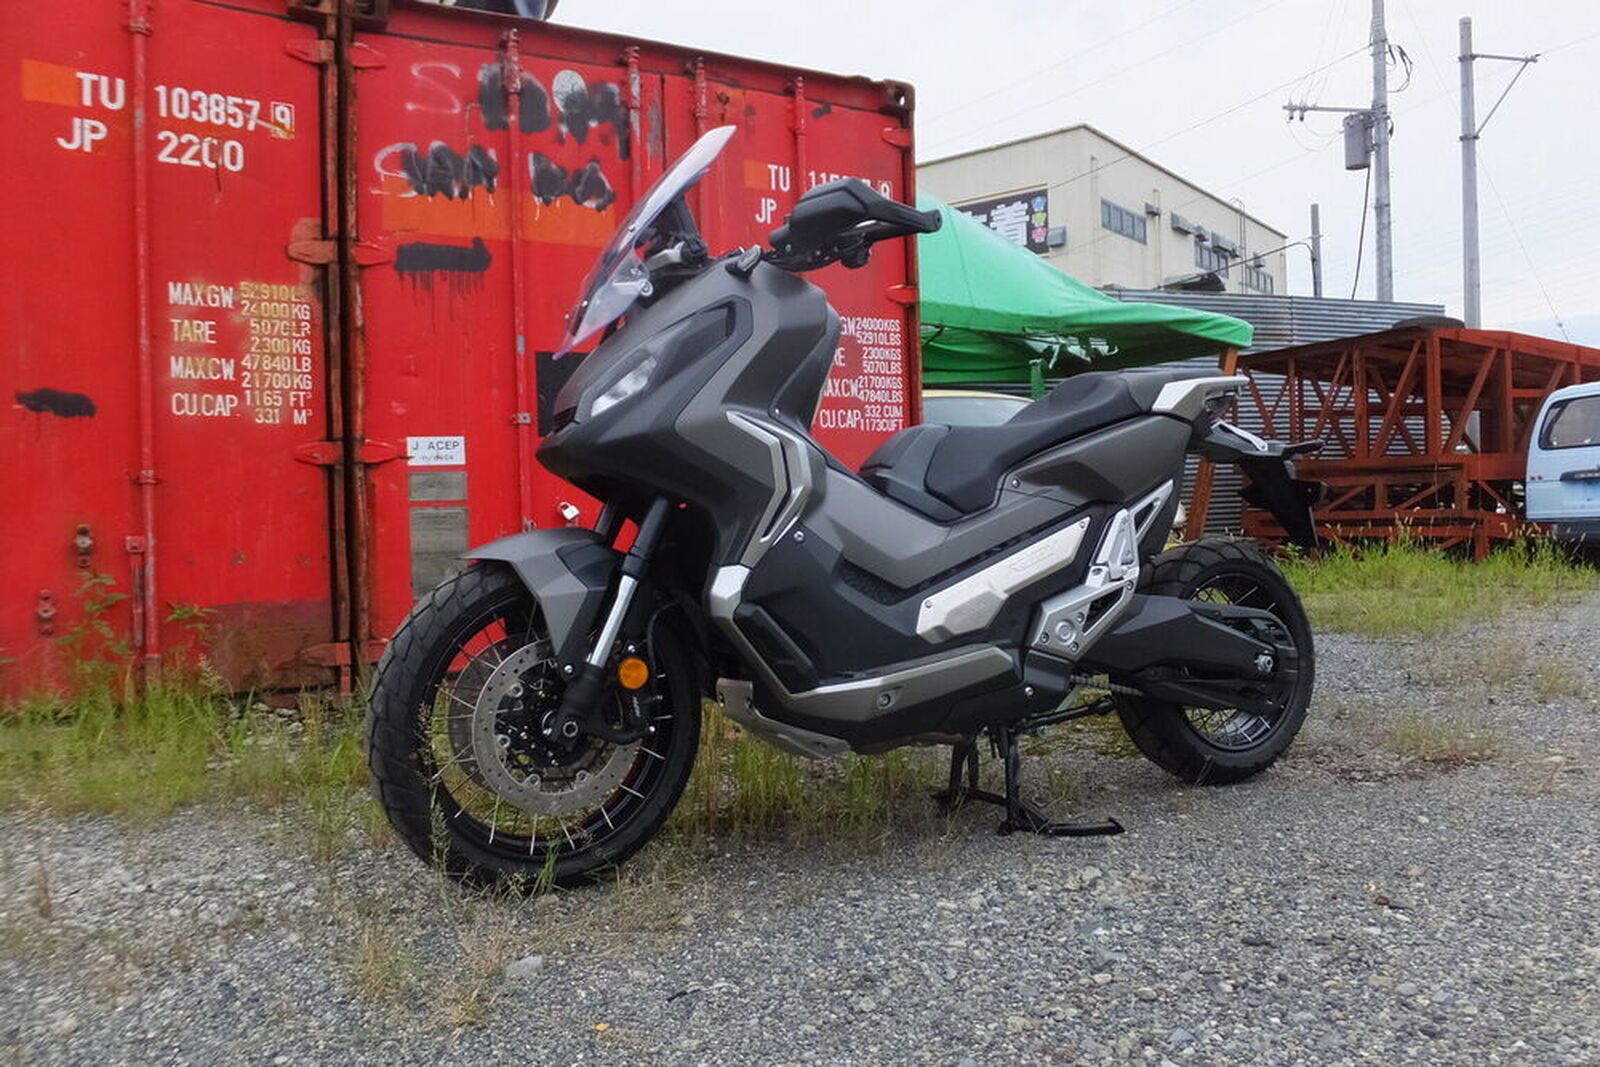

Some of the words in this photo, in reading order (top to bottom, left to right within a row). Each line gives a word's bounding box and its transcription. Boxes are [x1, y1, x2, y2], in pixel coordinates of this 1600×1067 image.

[76, 71, 126, 110] TU
[154, 85, 260, 131] 103857
[57, 117, 109, 153] JP
[767, 163, 792, 192] TU
[755, 197, 778, 225] JP
[169, 318, 217, 345] TARE
[244, 390, 283, 407] 1165
